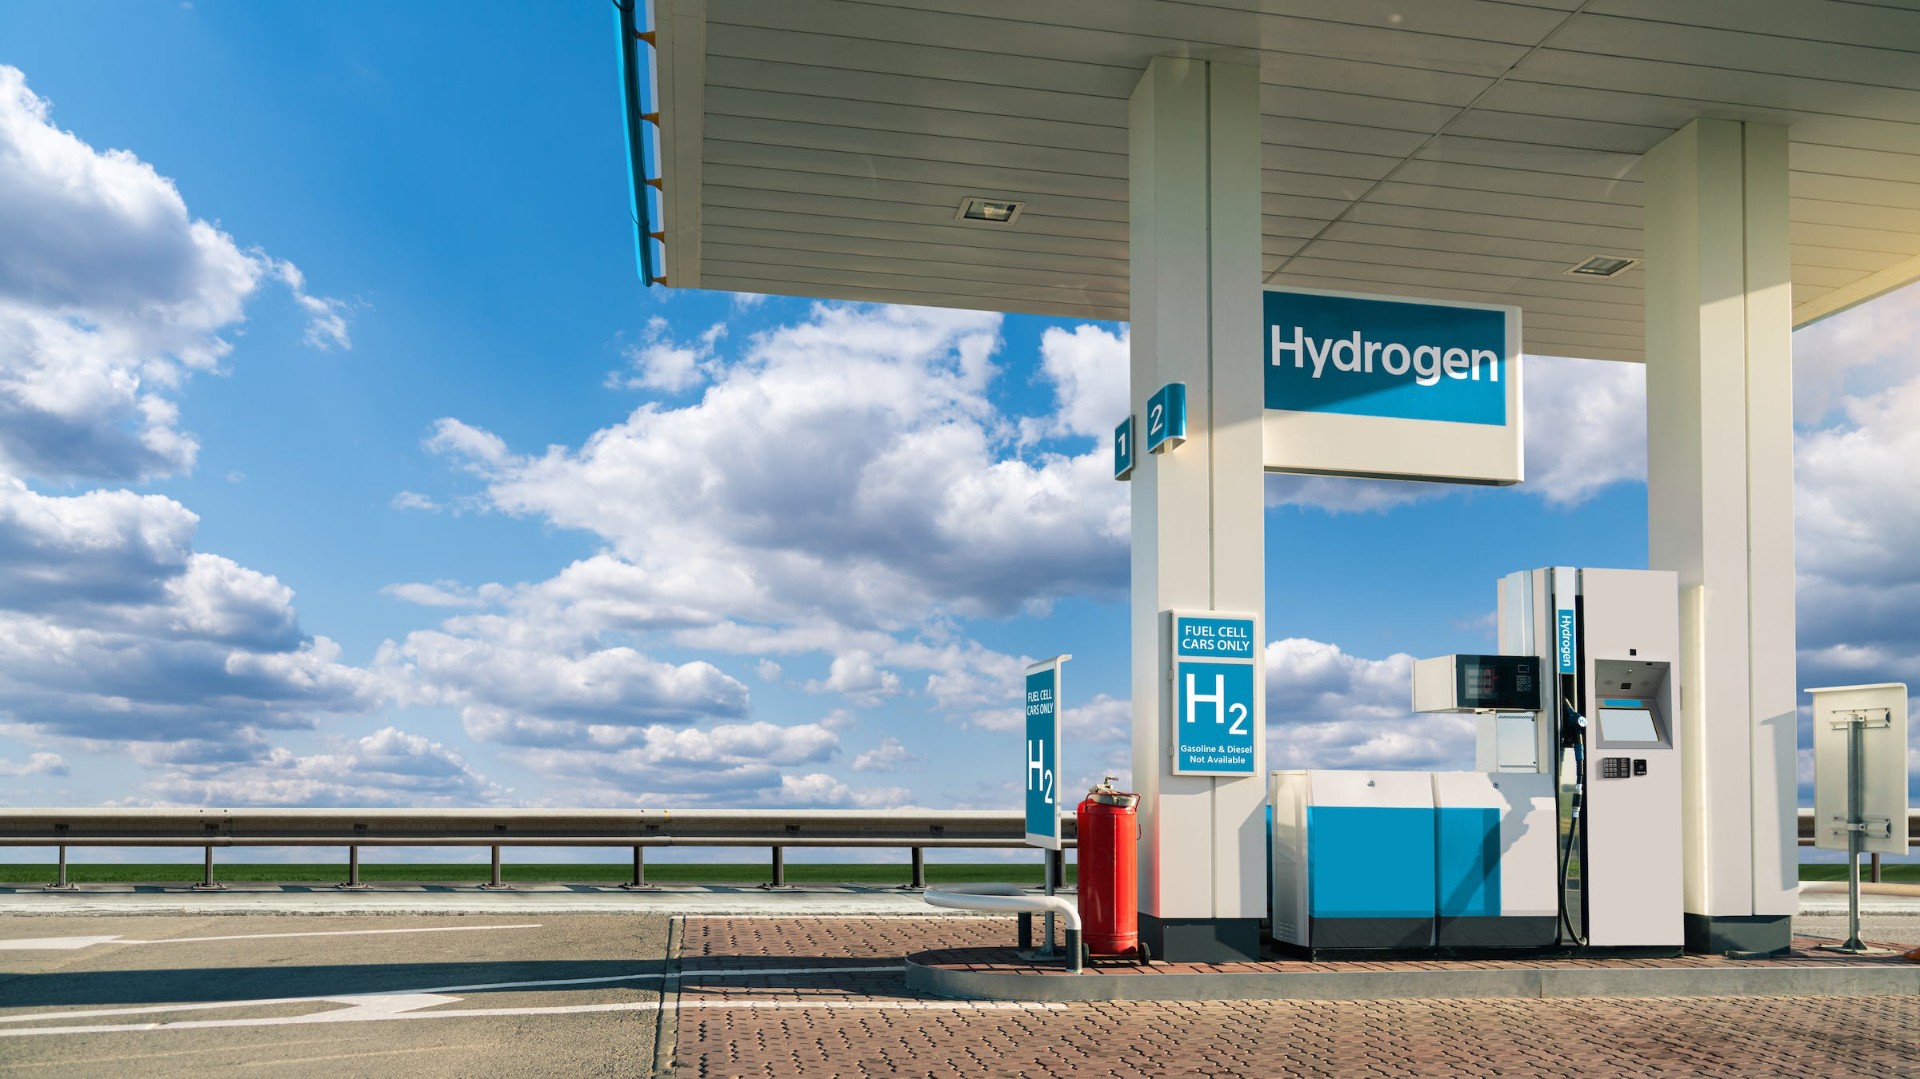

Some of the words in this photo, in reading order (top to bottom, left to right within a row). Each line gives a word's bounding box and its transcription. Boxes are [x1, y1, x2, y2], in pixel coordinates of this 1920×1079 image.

[1271, 324, 1498, 386] Hydrogen
[1150, 404, 1163, 436] 2
[1118, 432, 1126, 457] 1
[1185, 625, 1215, 637] FUEL
[1218, 626, 1247, 638] CELL
[1560, 615, 1572, 667] Hydrogen
[1182, 638, 1214, 650] CARS
[1217, 639, 1250, 651] ONLY
[1027, 691, 1040, 702] FUEL
[1040, 689, 1052, 700] CELL
[1186, 673, 1248, 735] H2
[1027, 704, 1039, 716] CARS
[1040, 702, 1053, 714] ONLY
[1180, 744, 1216, 753] Gasoline
[1218, 745, 1225, 753] &
[1227, 745, 1252, 754] Diesel
[1190, 755, 1205, 763] Not
[1207, 755, 1246, 764] Available
[1028, 739, 1053, 804] H2
